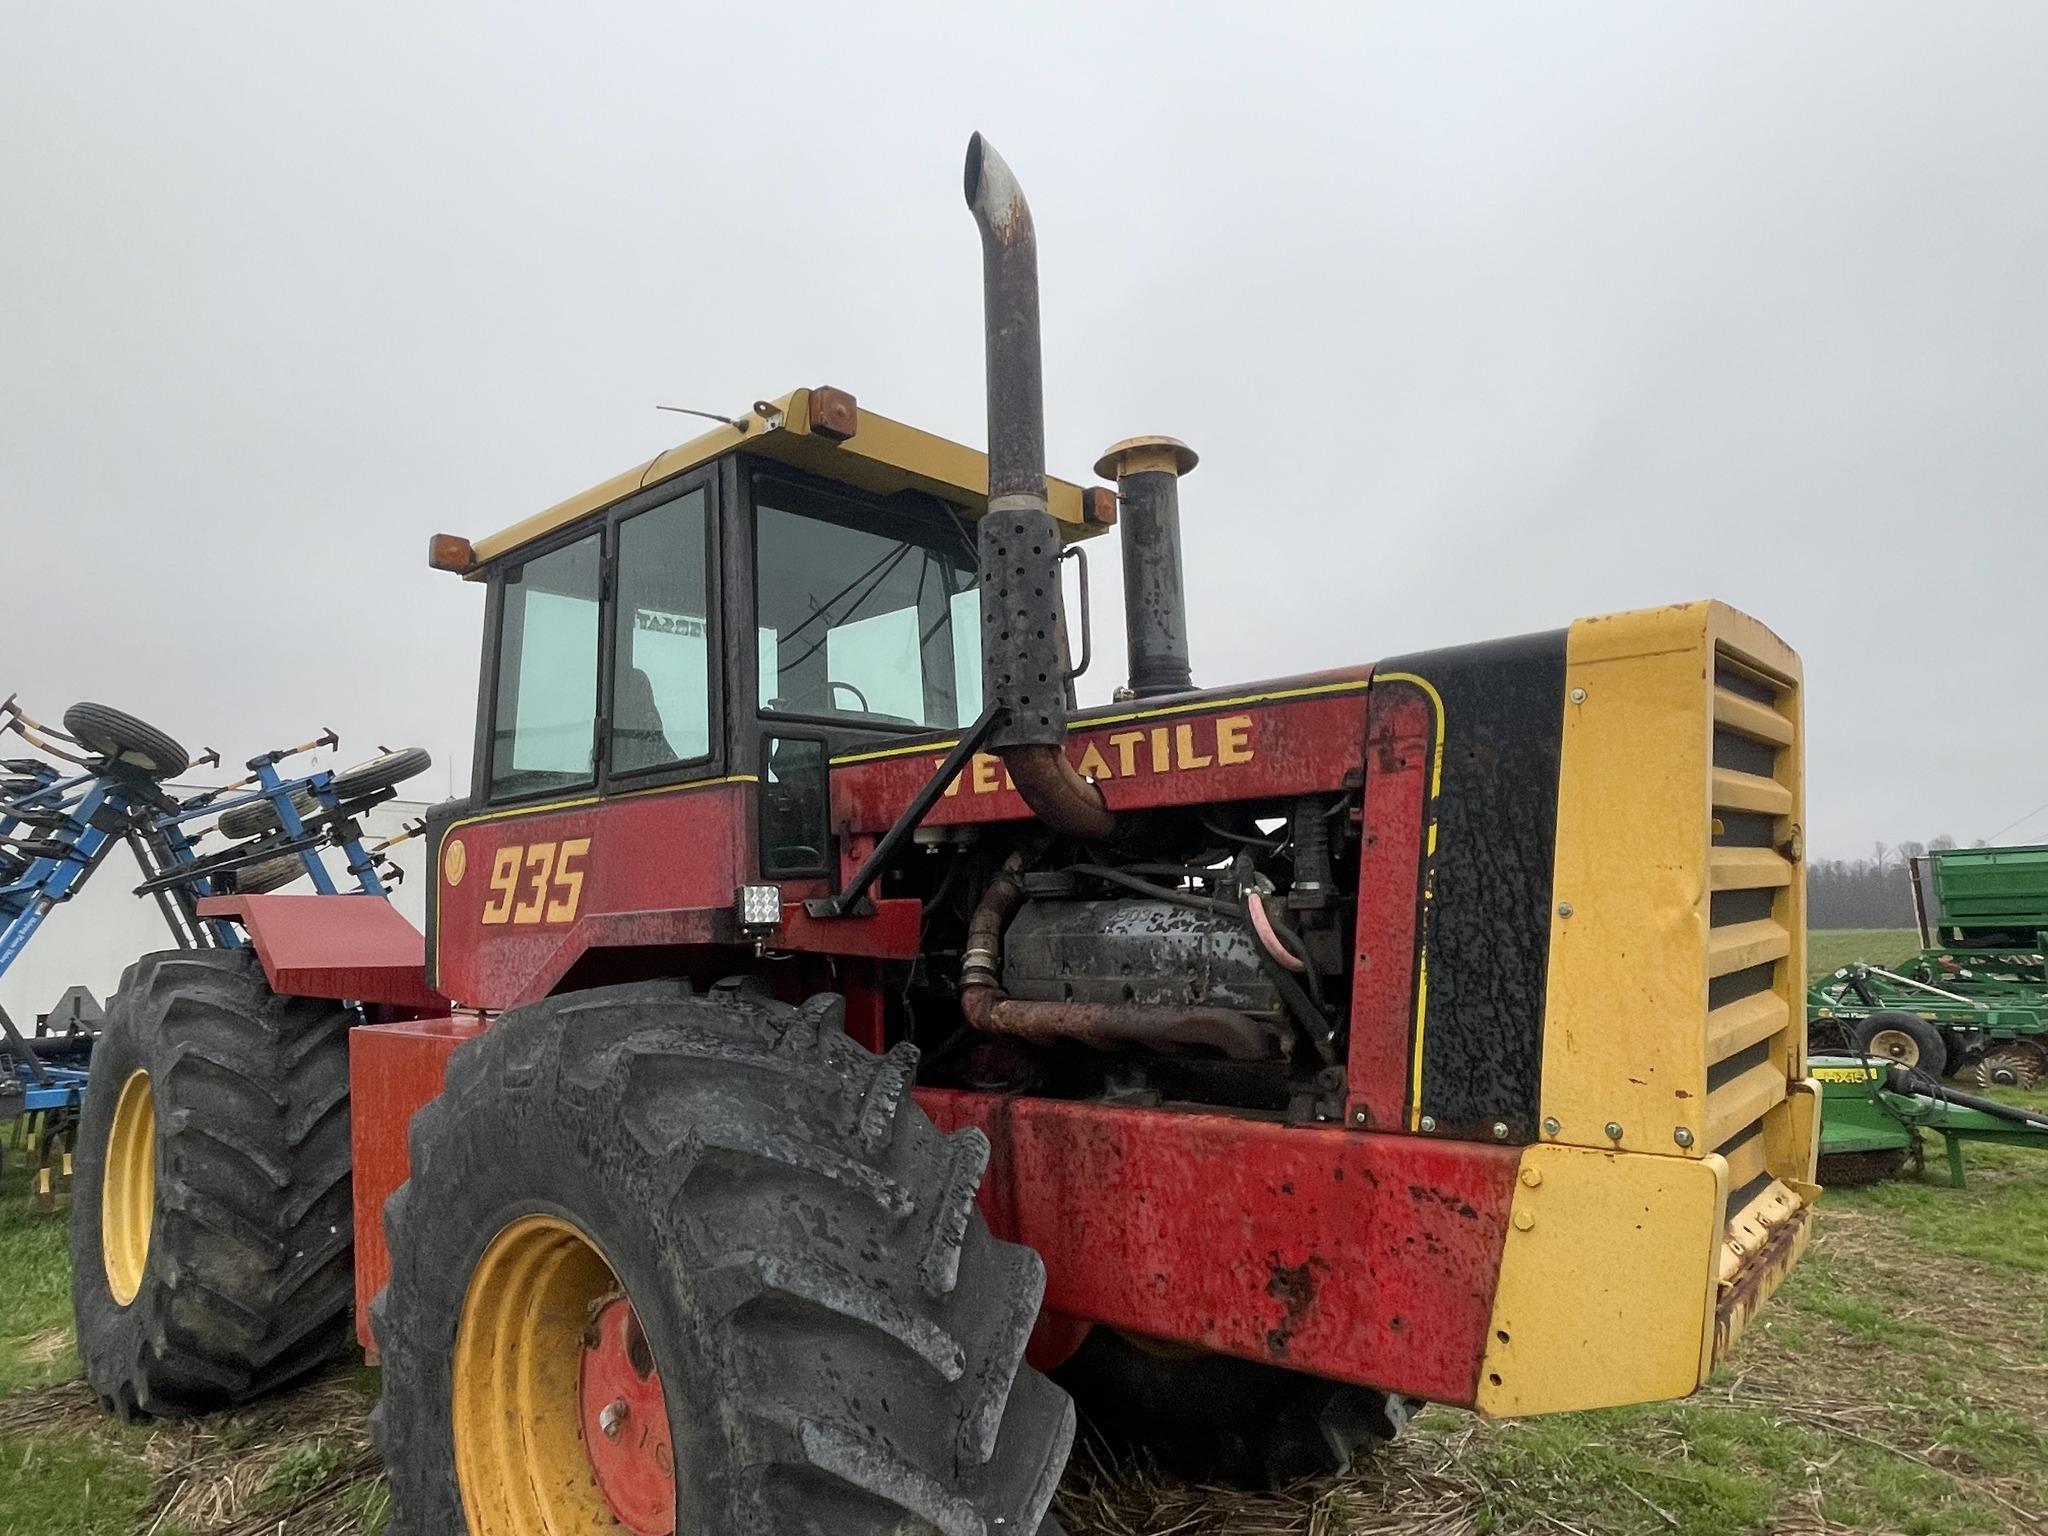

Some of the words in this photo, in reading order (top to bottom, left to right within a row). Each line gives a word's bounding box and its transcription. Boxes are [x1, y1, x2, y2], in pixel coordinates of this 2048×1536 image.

[934, 714, 1255, 797] EATILE
[482, 838, 591, 924] 935
[1823, 1071, 1864, 1083] HX15
